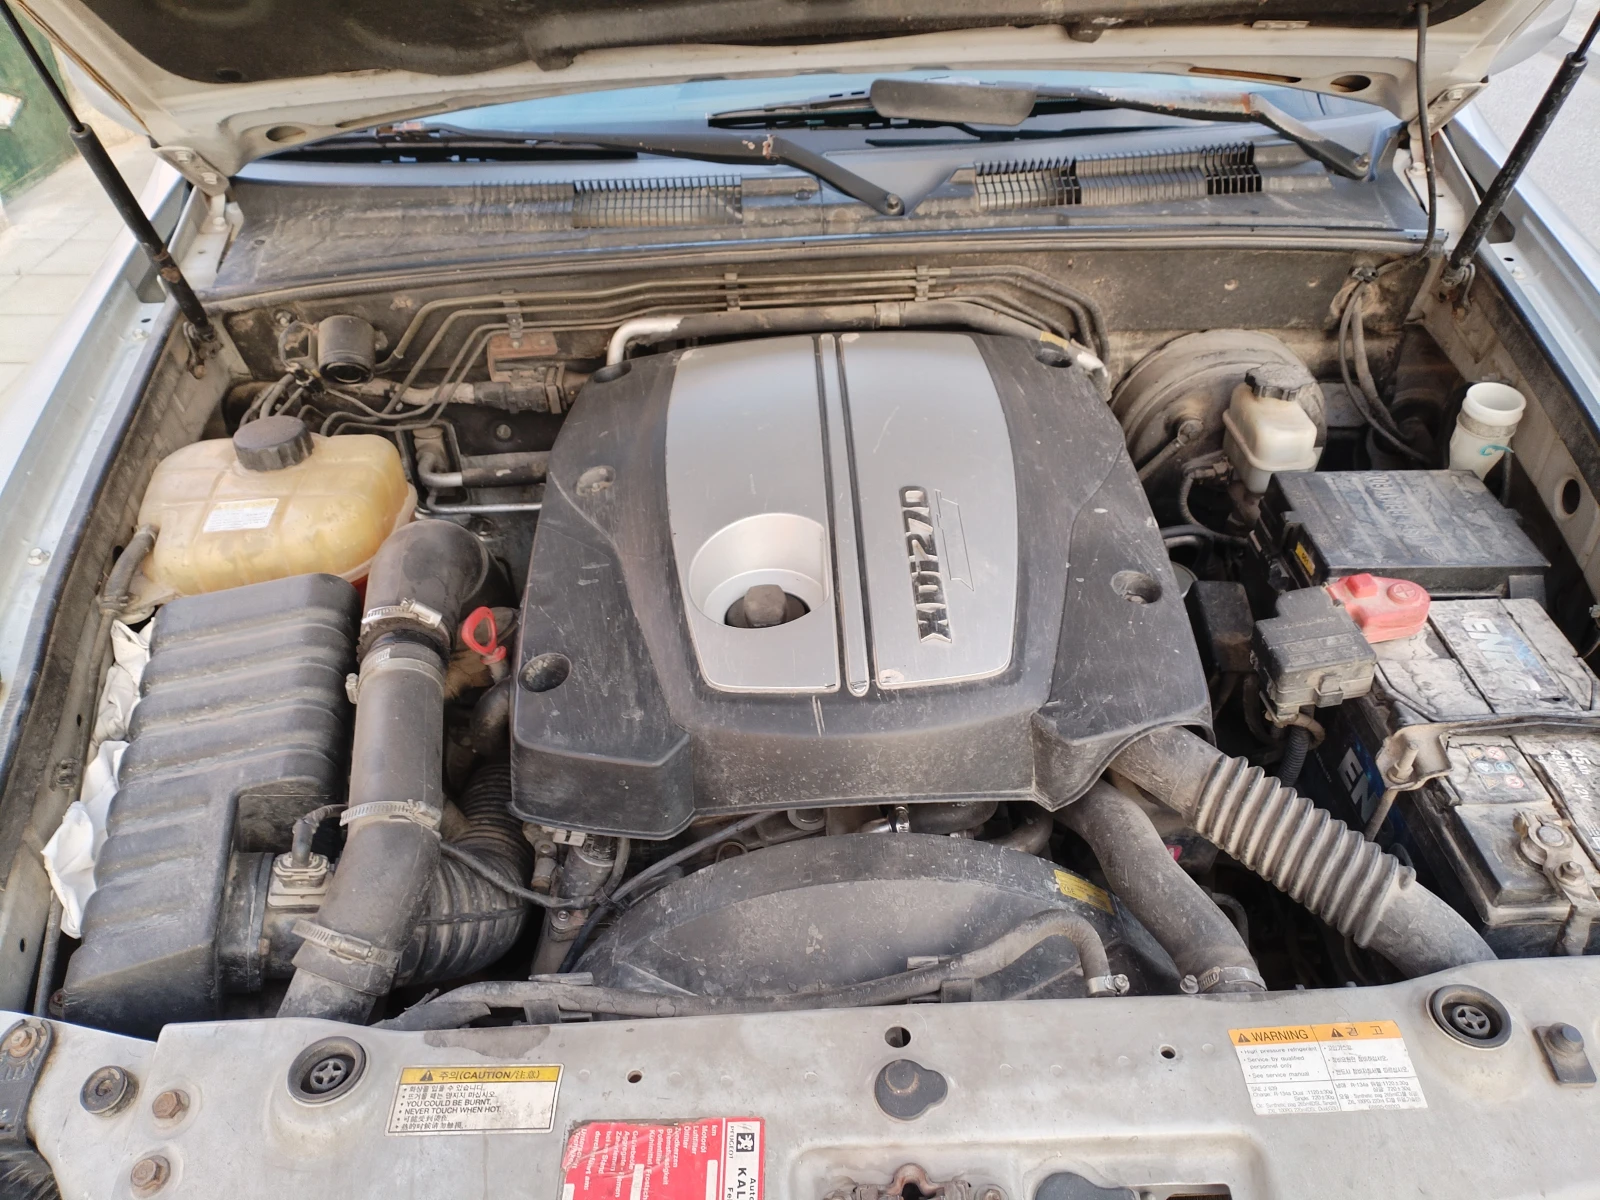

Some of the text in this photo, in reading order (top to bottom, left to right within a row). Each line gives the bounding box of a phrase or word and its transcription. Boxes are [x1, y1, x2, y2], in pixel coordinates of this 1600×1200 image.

[1250, 1029, 1308, 1042] WARNING
[1370, 1026, 1384, 1035] 고
[682, 1126, 691, 1149] Ölfilter
[691, 1125, 699, 1155] Luftfilter
[699, 1125, 708, 1153] Motoröl
[711, 1125, 718, 1136] km
[646, 1129, 655, 1165] Kühlmittel
[655, 1129, 663, 1165] Pollenfilter
[672, 1127, 681, 1168] Zündkerzen
[597, 1154, 608, 1175] Stand
